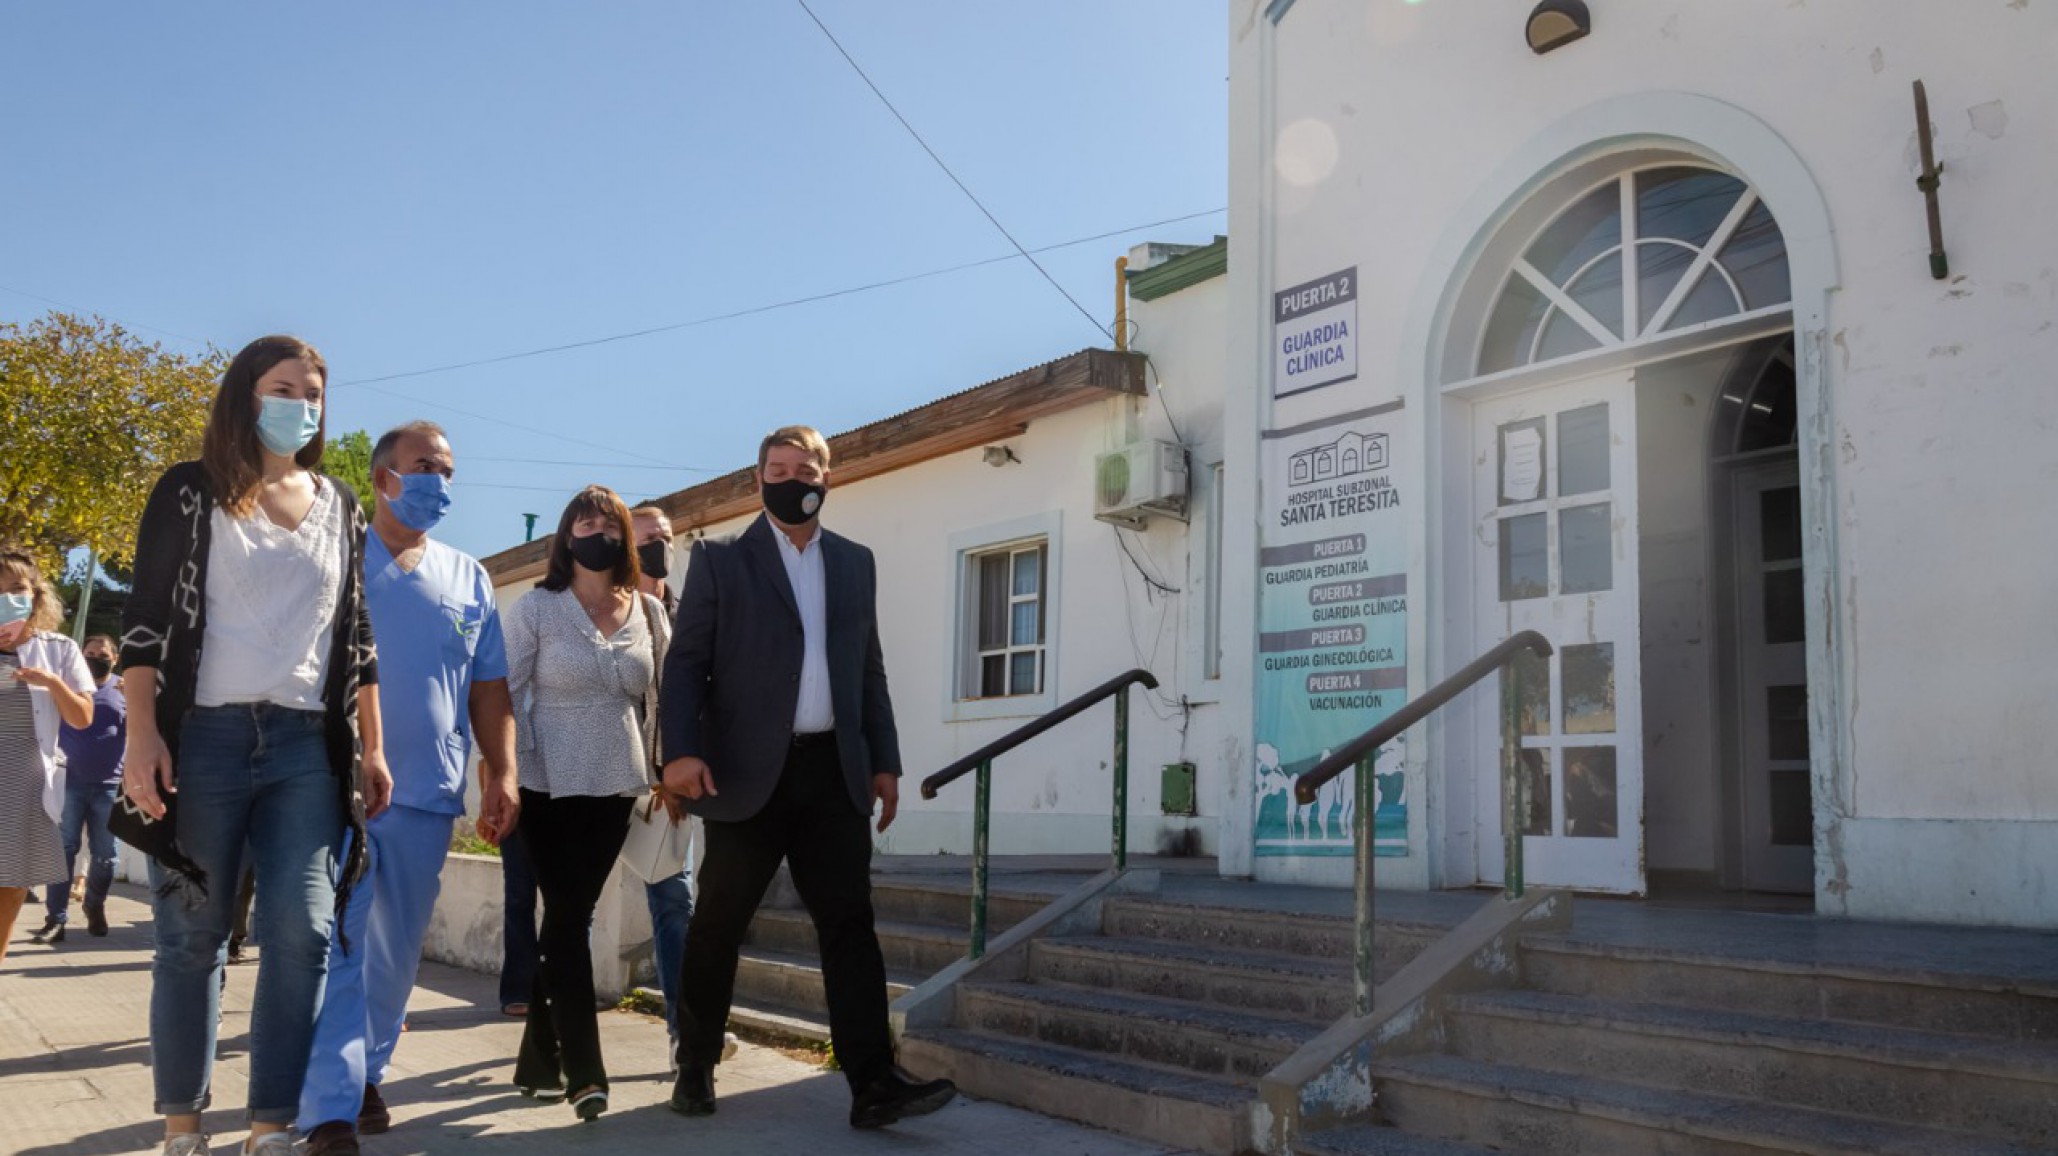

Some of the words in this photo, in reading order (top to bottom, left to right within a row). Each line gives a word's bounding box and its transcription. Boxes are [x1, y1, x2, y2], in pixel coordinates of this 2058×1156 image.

[1281, 281, 1337, 315] PUERTA
[1339, 276, 1350, 295] 2
[1283, 320, 1348, 354] GUARDIA
[1287, 344, 1345, 376] CLÍNICA
[1288, 486, 1334, 506] HOSPITAL
[1337, 475, 1392, 496] SUBZONAL
[1281, 502, 1326, 527] SANTA
[1330, 488, 1400, 518] TERESITA
[1314, 539, 1354, 556] PUERTA
[1356, 536, 1363, 550] 1
[1266, 568, 1313, 584] GUARDIA
[1315, 558, 1369, 578] PEDIATRÍA
[1312, 585, 1354, 602] PUERTA
[1355, 583, 1363, 597] 2
[1312, 604, 1361, 622] GUARDIA
[1363, 597, 1407, 616] CLÍNICA
[1311, 628, 1354, 645] PUERTA
[1354, 627, 1362, 641] 3
[1265, 655, 1310, 671] GUARDIA
[1312, 648, 1393, 667] GINECOLÓGICA
[1309, 675, 1352, 690] PUERTA
[1353, 674, 1361, 688] 4
[1309, 691, 1382, 710] VACUNACIÓN
